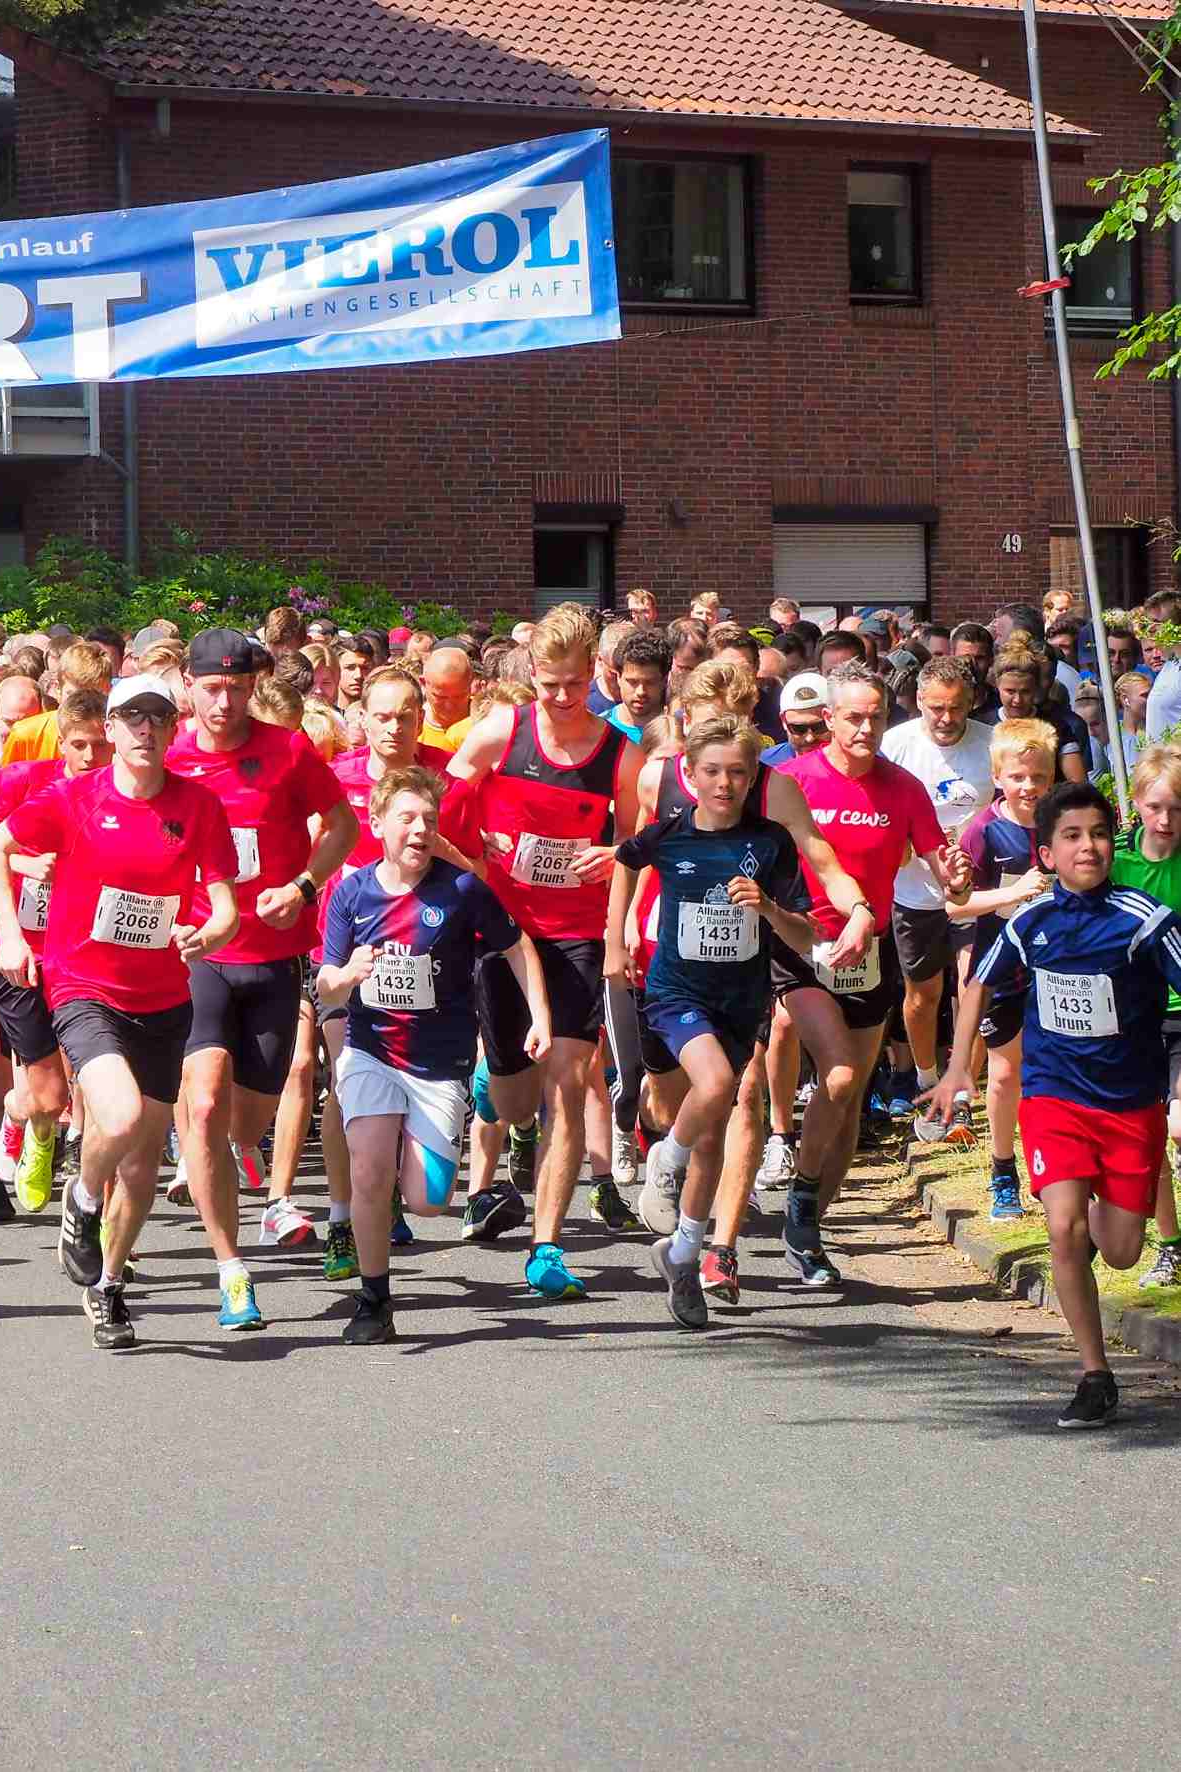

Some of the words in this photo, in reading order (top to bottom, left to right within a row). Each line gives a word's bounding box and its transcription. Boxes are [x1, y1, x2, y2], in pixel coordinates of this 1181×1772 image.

[206, 207, 579, 291] VIEROL
[227, 279, 582, 324] AKTIENGESELLSCHAFT
[1002, 534, 1022, 552] 49
[839, 809, 891, 828] cewe
[536, 839, 566, 849] Allianz
[532, 855, 574, 870] 2067
[531, 869, 567, 884] bruns
[119, 893, 151, 906] Allianz
[697, 906, 730, 917] Allianz
[114, 911, 159, 930] 2068
[113, 925, 152, 944] bruns
[699, 926, 740, 941] 1431
[700, 941, 738, 957] bruns
[375, 956, 402, 967] llianz
[374, 974, 416, 990] 1432
[834, 975, 865, 988] bruns
[1046, 974, 1077, 987] Allianz
[377, 989, 414, 1005] bruns
[1050, 995, 1093, 1014] 1433
[1053, 1011, 1092, 1031] bruns
